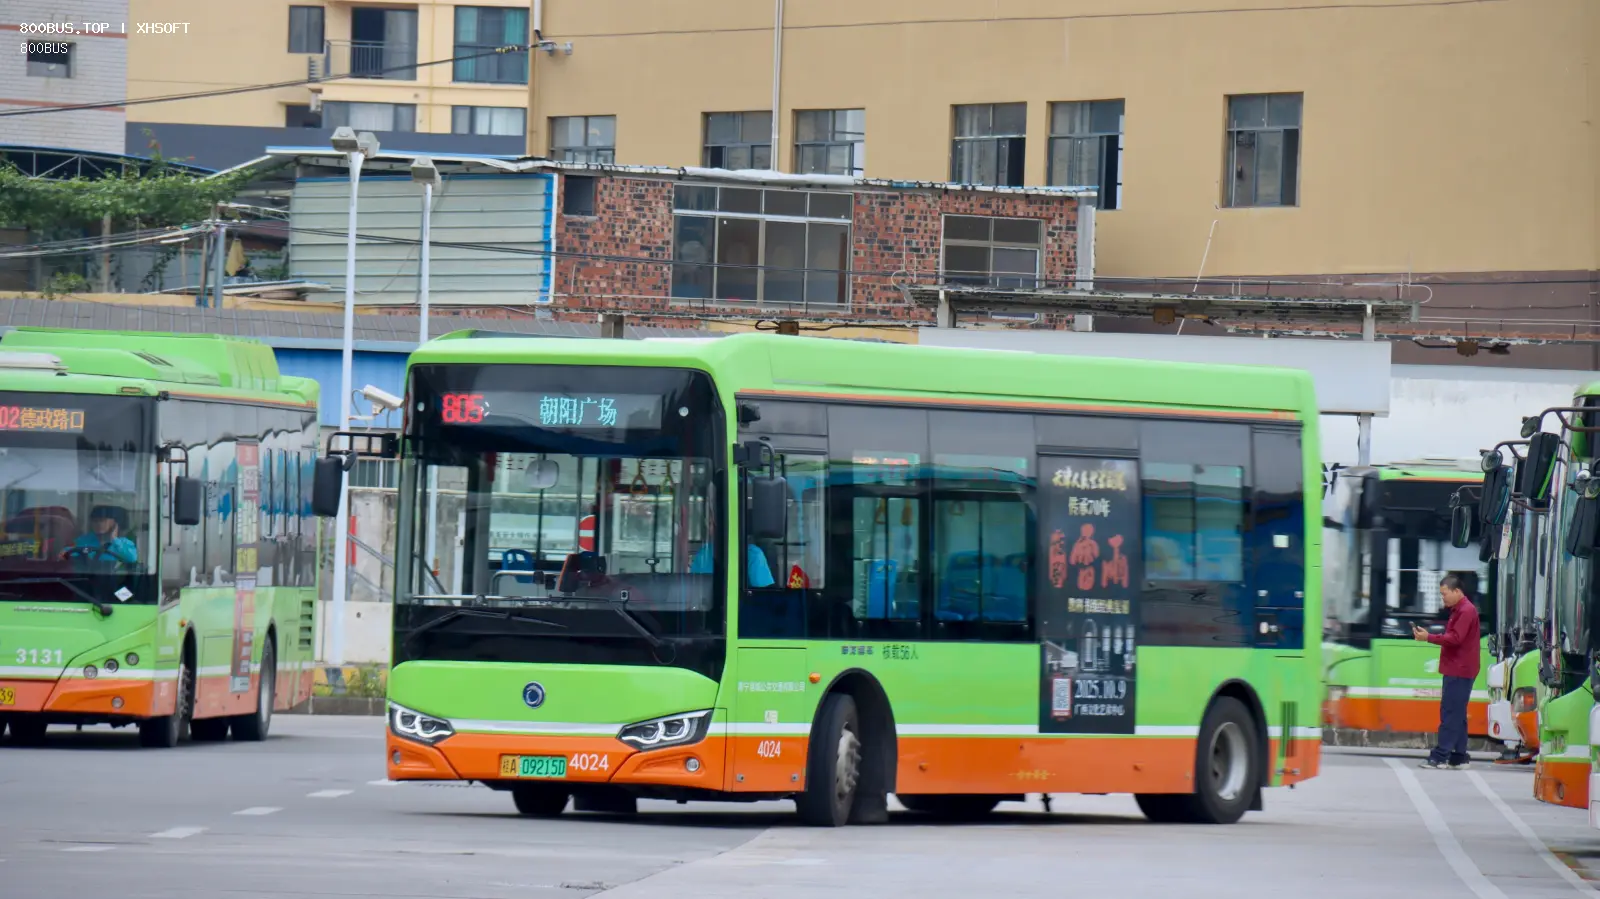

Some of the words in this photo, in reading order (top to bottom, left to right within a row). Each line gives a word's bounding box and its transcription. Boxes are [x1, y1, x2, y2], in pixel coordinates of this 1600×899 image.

[20, 407, 85, 431] 德政路口
[441, 393, 484, 424] 805
[538, 396, 618, 426] 朝阳广场
[15, 648, 63, 665] 3131
[1074, 679, 1127, 699] 2025.10.9
[757, 740, 781, 758] 4024
[568, 753, 609, 771] 4024
